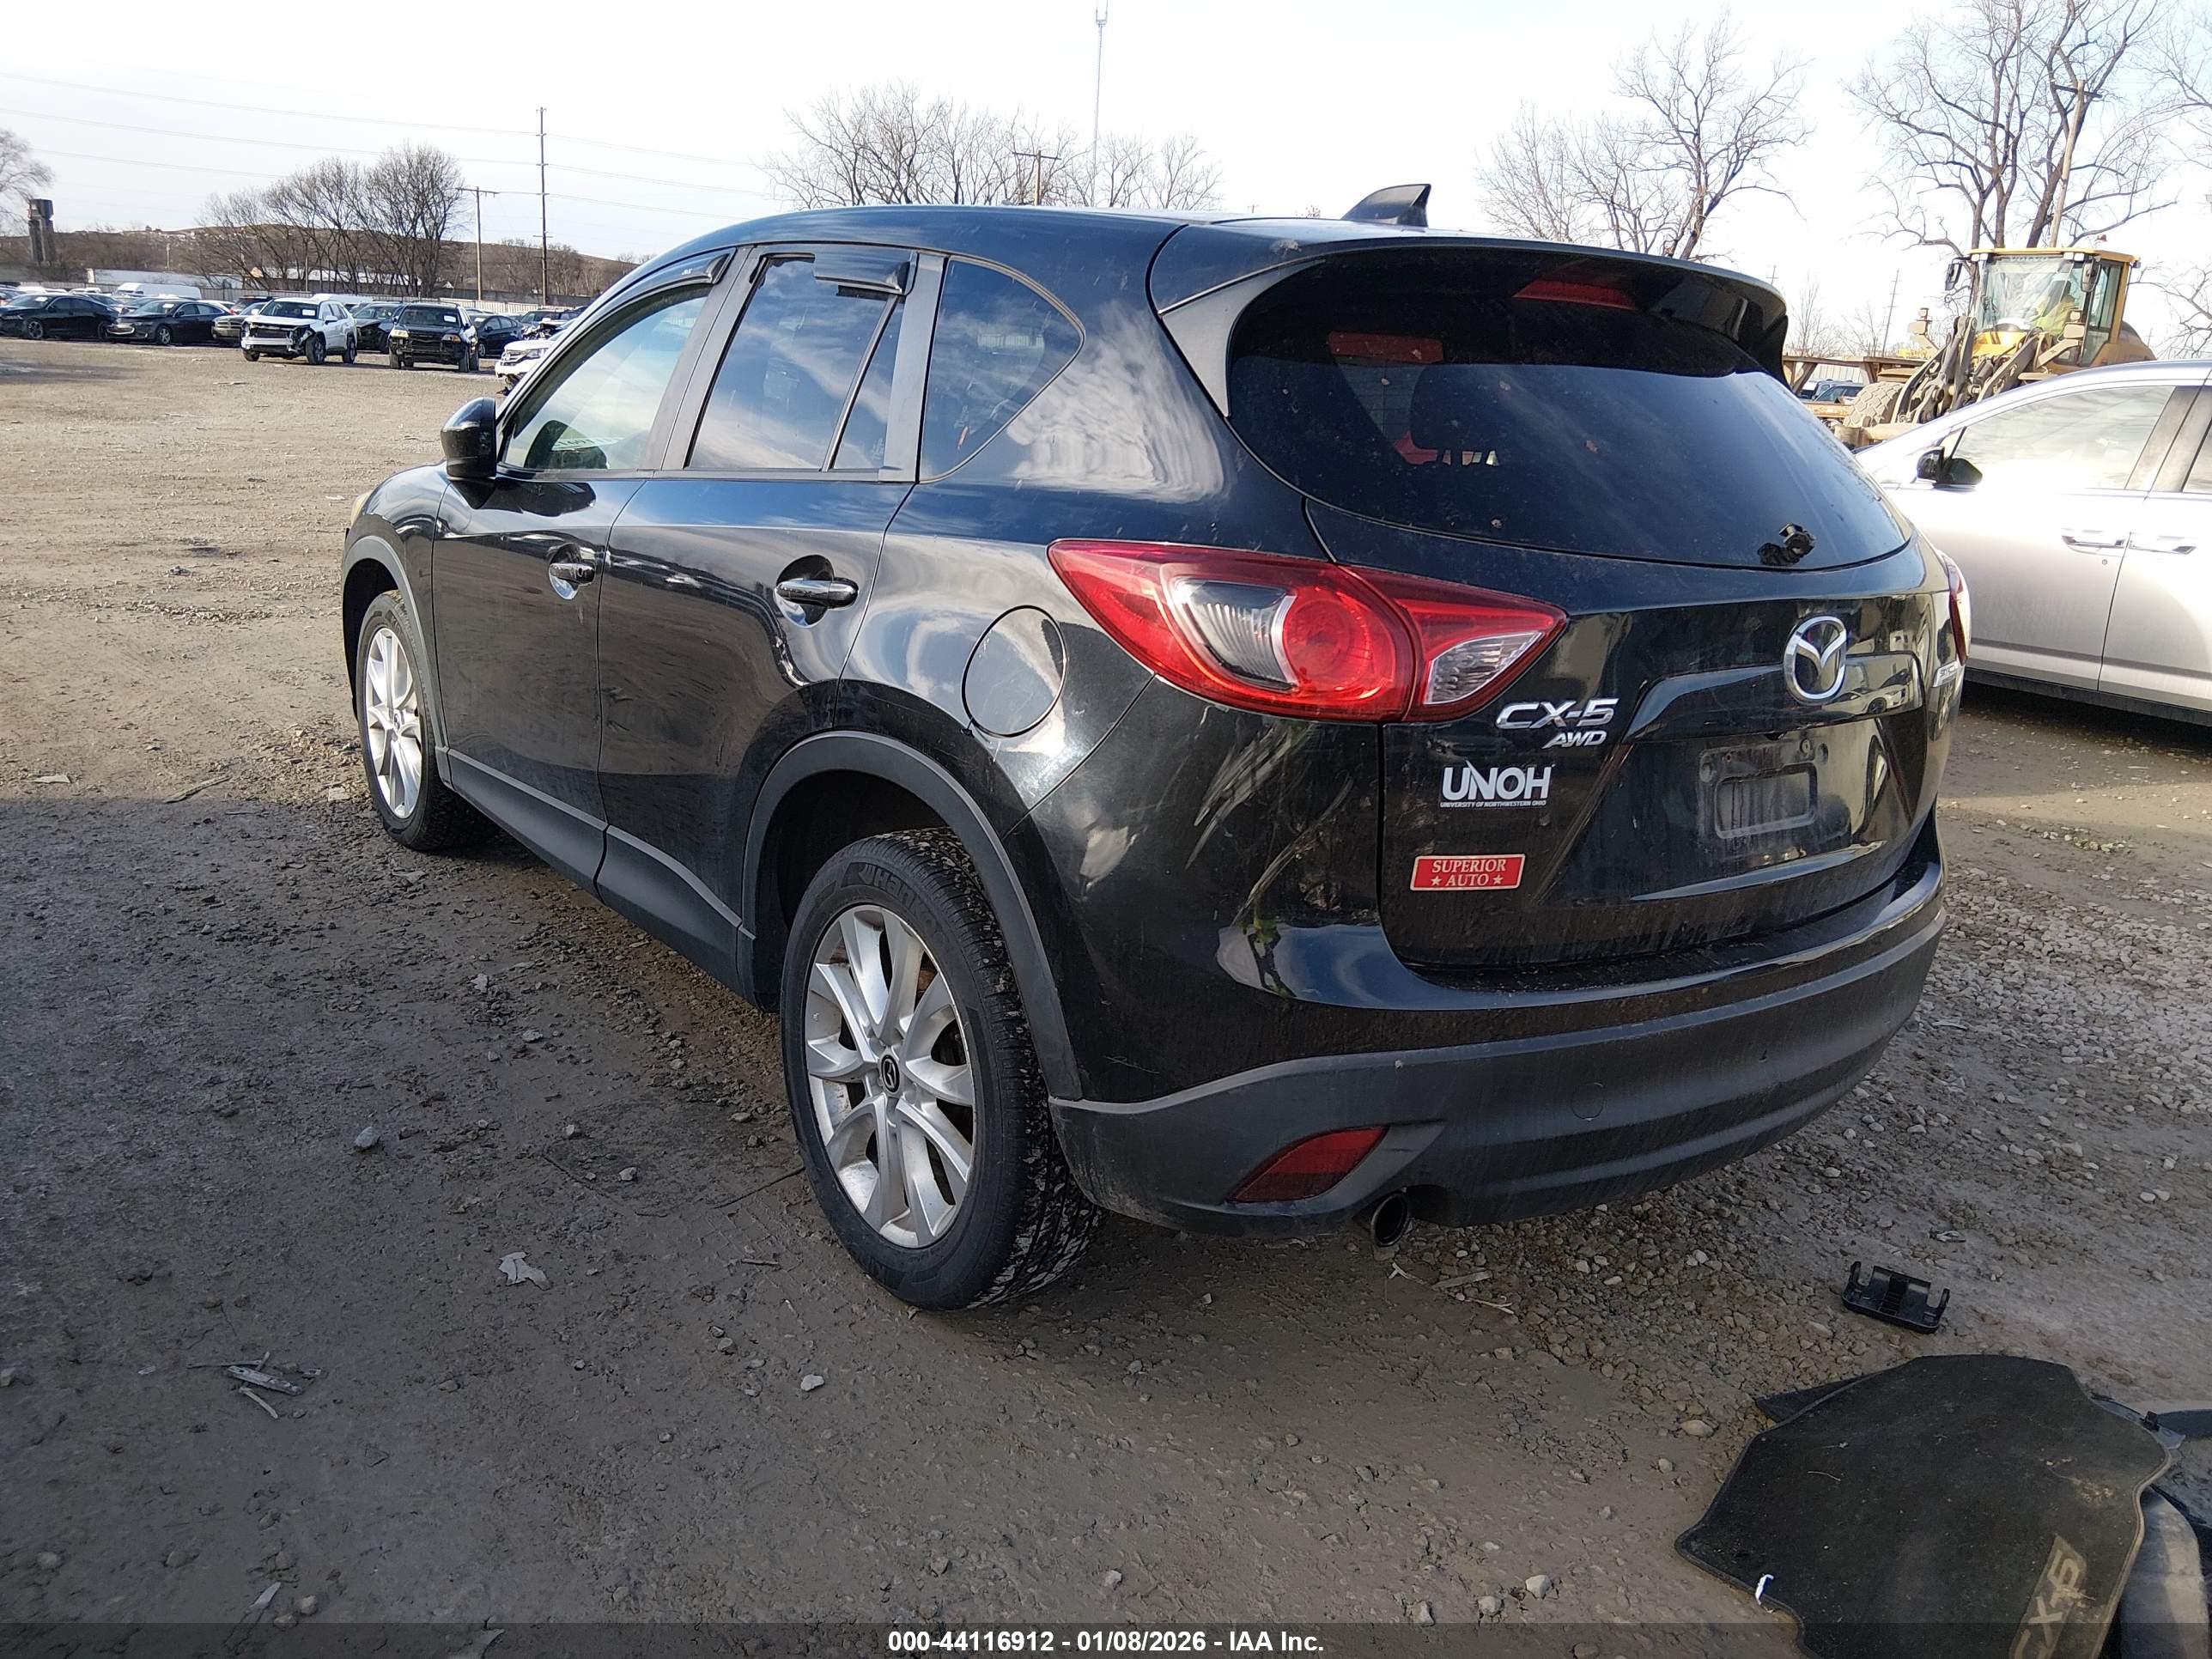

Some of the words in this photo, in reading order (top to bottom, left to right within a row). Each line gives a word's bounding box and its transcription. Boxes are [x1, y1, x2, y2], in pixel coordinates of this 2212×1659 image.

[1496, 698, 1620, 729] CX-5
[1541, 731, 1607, 750] AWD
[1442, 760, 1553, 800] UNOH
[1431, 859, 1507, 873] SUPERIOR
[1444, 873, 1490, 887] AUTO
